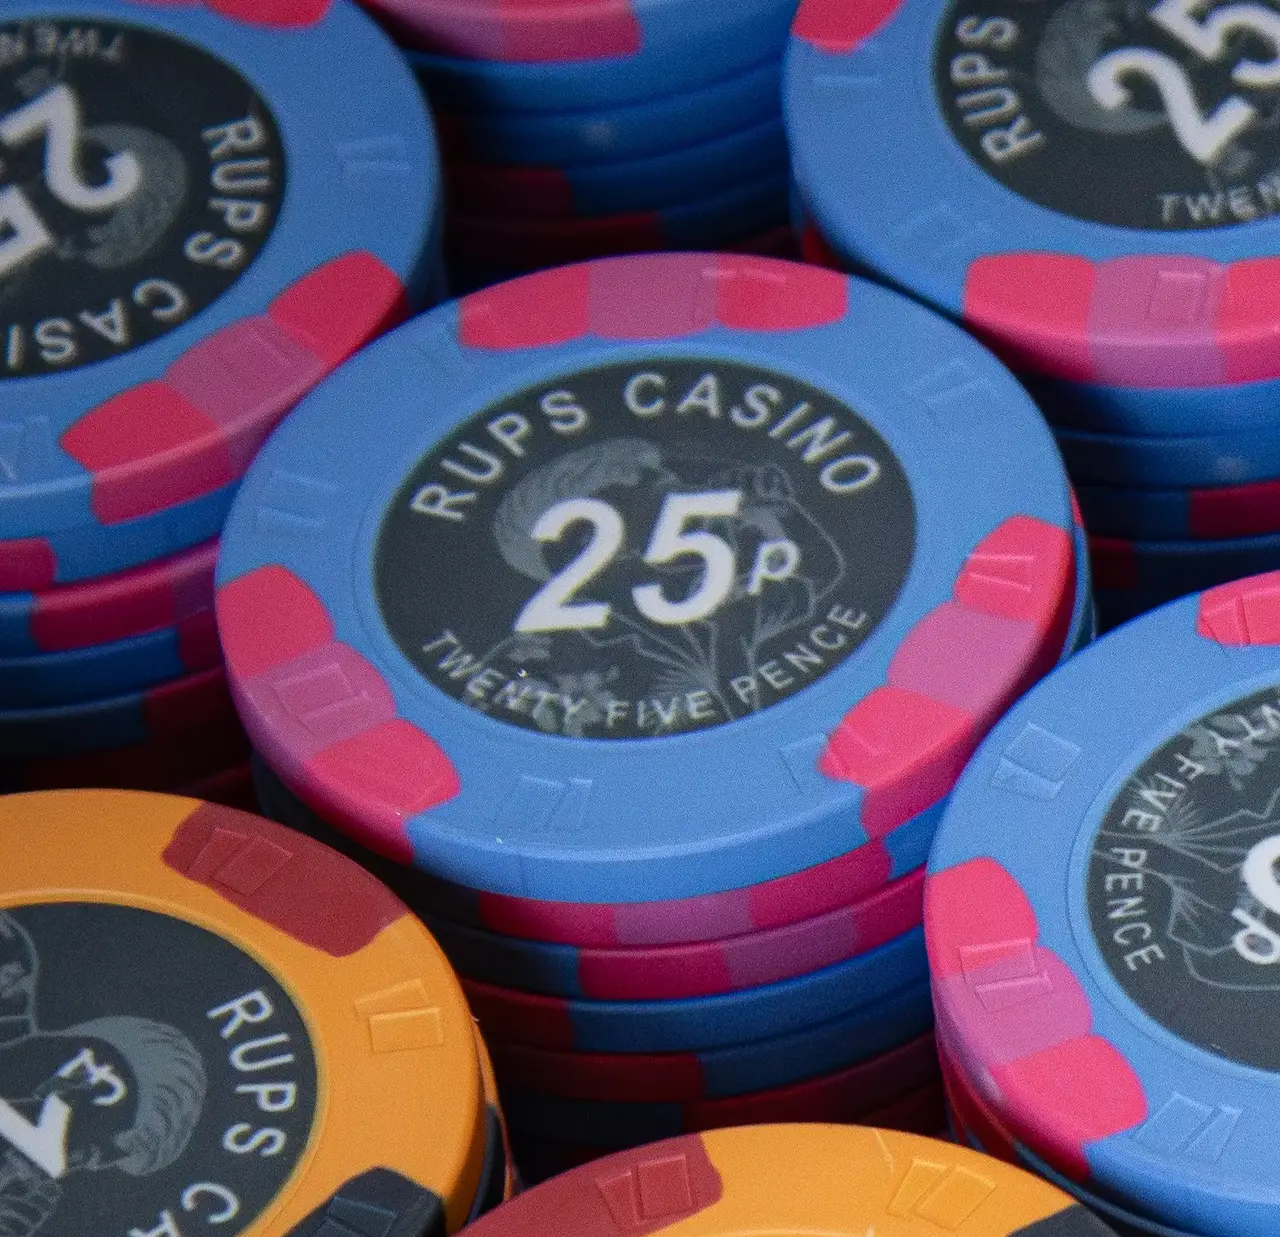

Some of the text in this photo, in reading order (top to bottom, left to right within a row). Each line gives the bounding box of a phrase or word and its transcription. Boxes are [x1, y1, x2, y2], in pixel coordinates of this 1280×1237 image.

[950, 15, 1046, 163] RUPS
[184, 114, 272, 270] RUPS
[411, 372, 883, 523] RUPS CASINO
[513, 487, 801, 633] 25p
[421, 602, 868, 728] TWENTY FIVE PENCE
[1120, 752, 1207, 834] FIVE
[1104, 846, 1166, 972] PENCE
[206, 988, 299, 1158] RUPS
